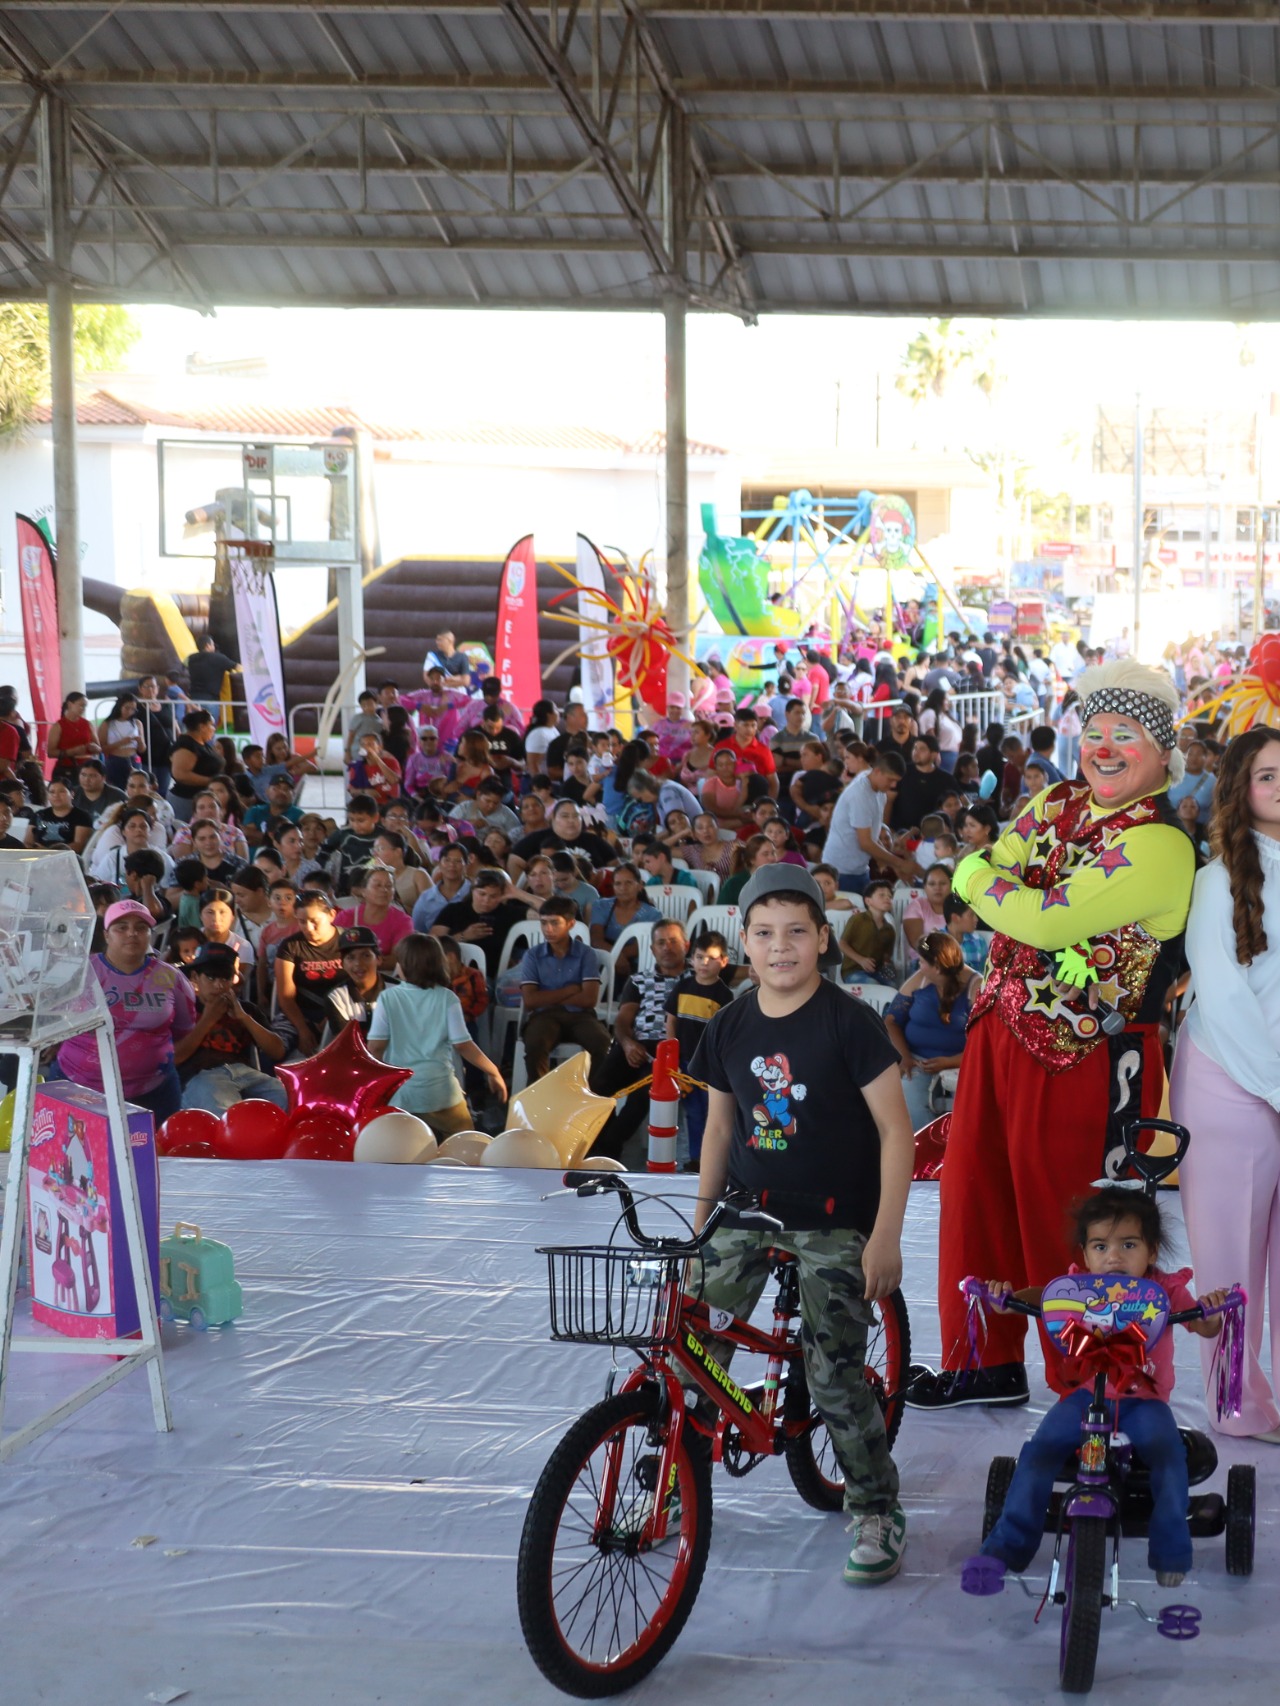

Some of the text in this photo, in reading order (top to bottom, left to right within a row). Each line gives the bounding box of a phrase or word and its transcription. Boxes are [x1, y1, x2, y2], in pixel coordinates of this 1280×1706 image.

[504, 619, 513, 649] EL
[301, 958, 343, 972] CHERRY
[124, 991, 166, 1008] DIF
[746, 1134, 788, 1151] MARIO
[1115, 1288, 1143, 1302] cool
[1121, 1299, 1149, 1313] cute
[686, 1332, 704, 1357] GP
